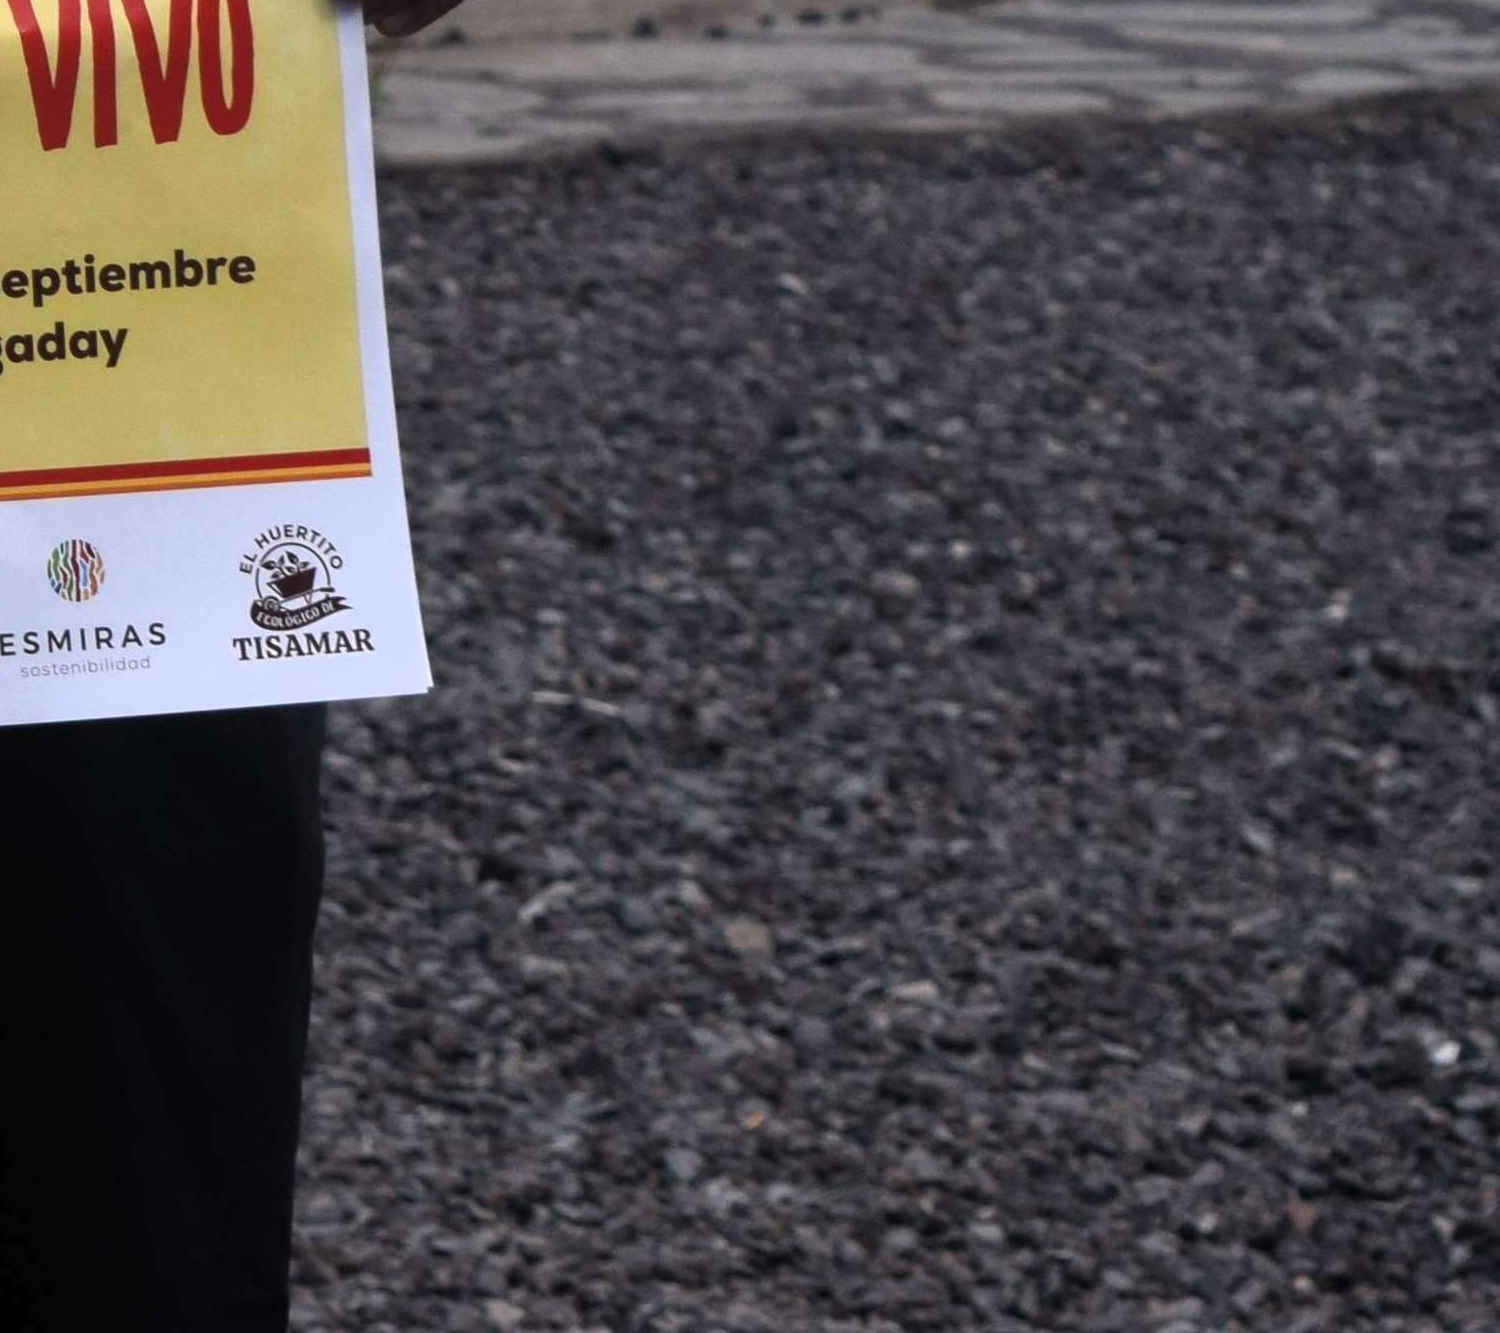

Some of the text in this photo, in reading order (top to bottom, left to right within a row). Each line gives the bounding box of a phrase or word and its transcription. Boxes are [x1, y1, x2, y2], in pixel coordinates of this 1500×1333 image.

[239, 524, 343, 574] EL HUERTITO
[232, 628, 375, 661] TISAMAR
[19, 655, 152, 680] sostenibilidad
